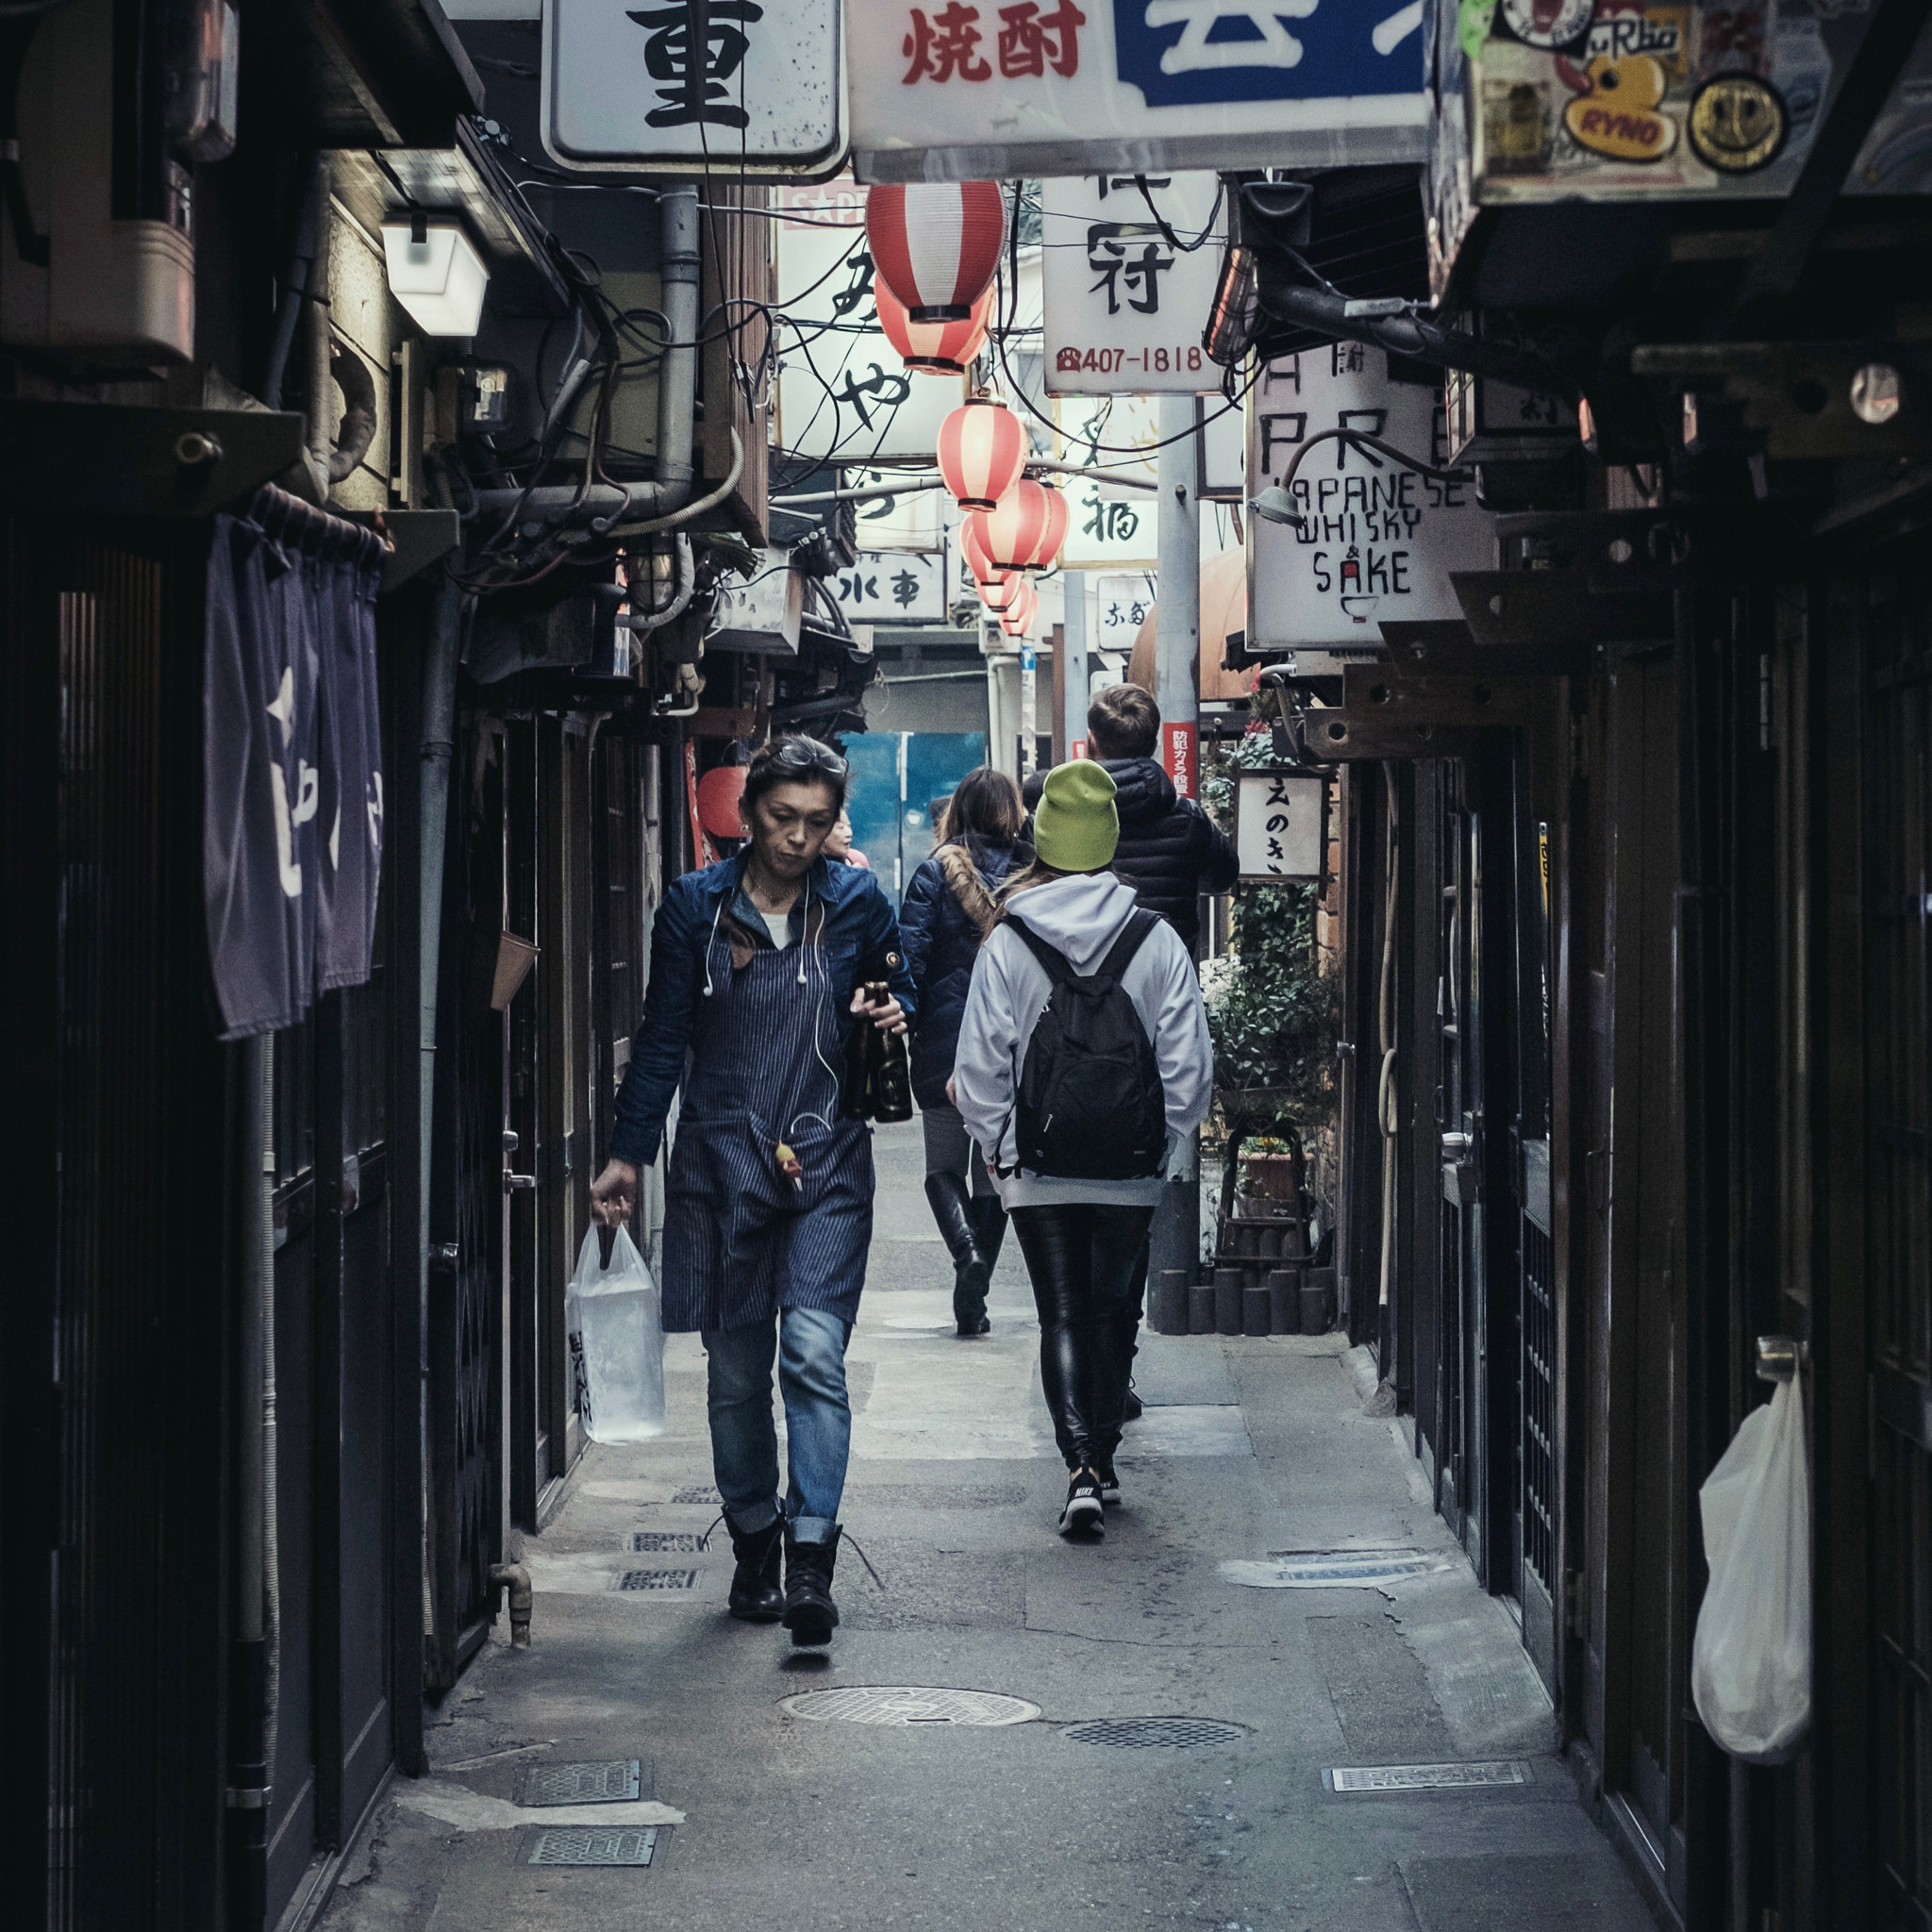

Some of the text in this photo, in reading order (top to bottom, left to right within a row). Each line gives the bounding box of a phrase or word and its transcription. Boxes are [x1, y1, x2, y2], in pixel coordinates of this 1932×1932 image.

[901, 0, 1086, 86] 焼酎
[1578, 108, 1660, 147] RYNO
[1082, 347, 1202, 372] 407-1818
[1274, 472, 1465, 514] APANESE
[1295, 508, 1421, 544] WHISKY
[1313, 547, 1410, 594] SAKE
[1345, 545, 1359, 558] &
[838, 568, 920, 610] 水車
[1265, 776, 1291, 874] えのき
[1074, 1487, 1093, 1498] NIKE
